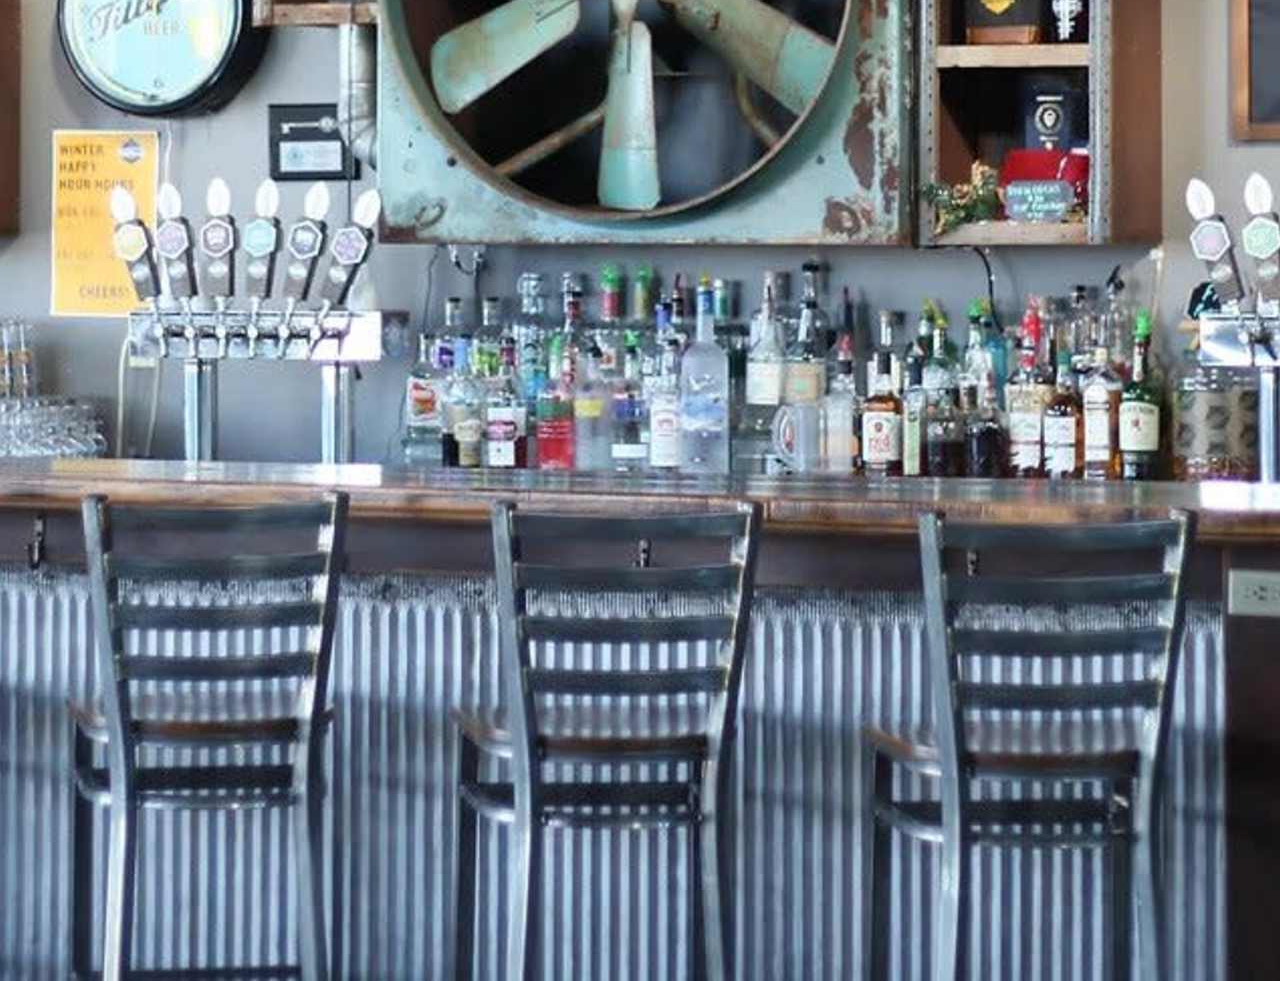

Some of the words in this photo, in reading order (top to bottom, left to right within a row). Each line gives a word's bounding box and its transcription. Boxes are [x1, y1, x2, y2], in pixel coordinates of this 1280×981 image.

[59, 145, 104, 156] WINTER
[59, 163, 96, 174] HAPPY
[59, 179, 91, 190] HOUR
